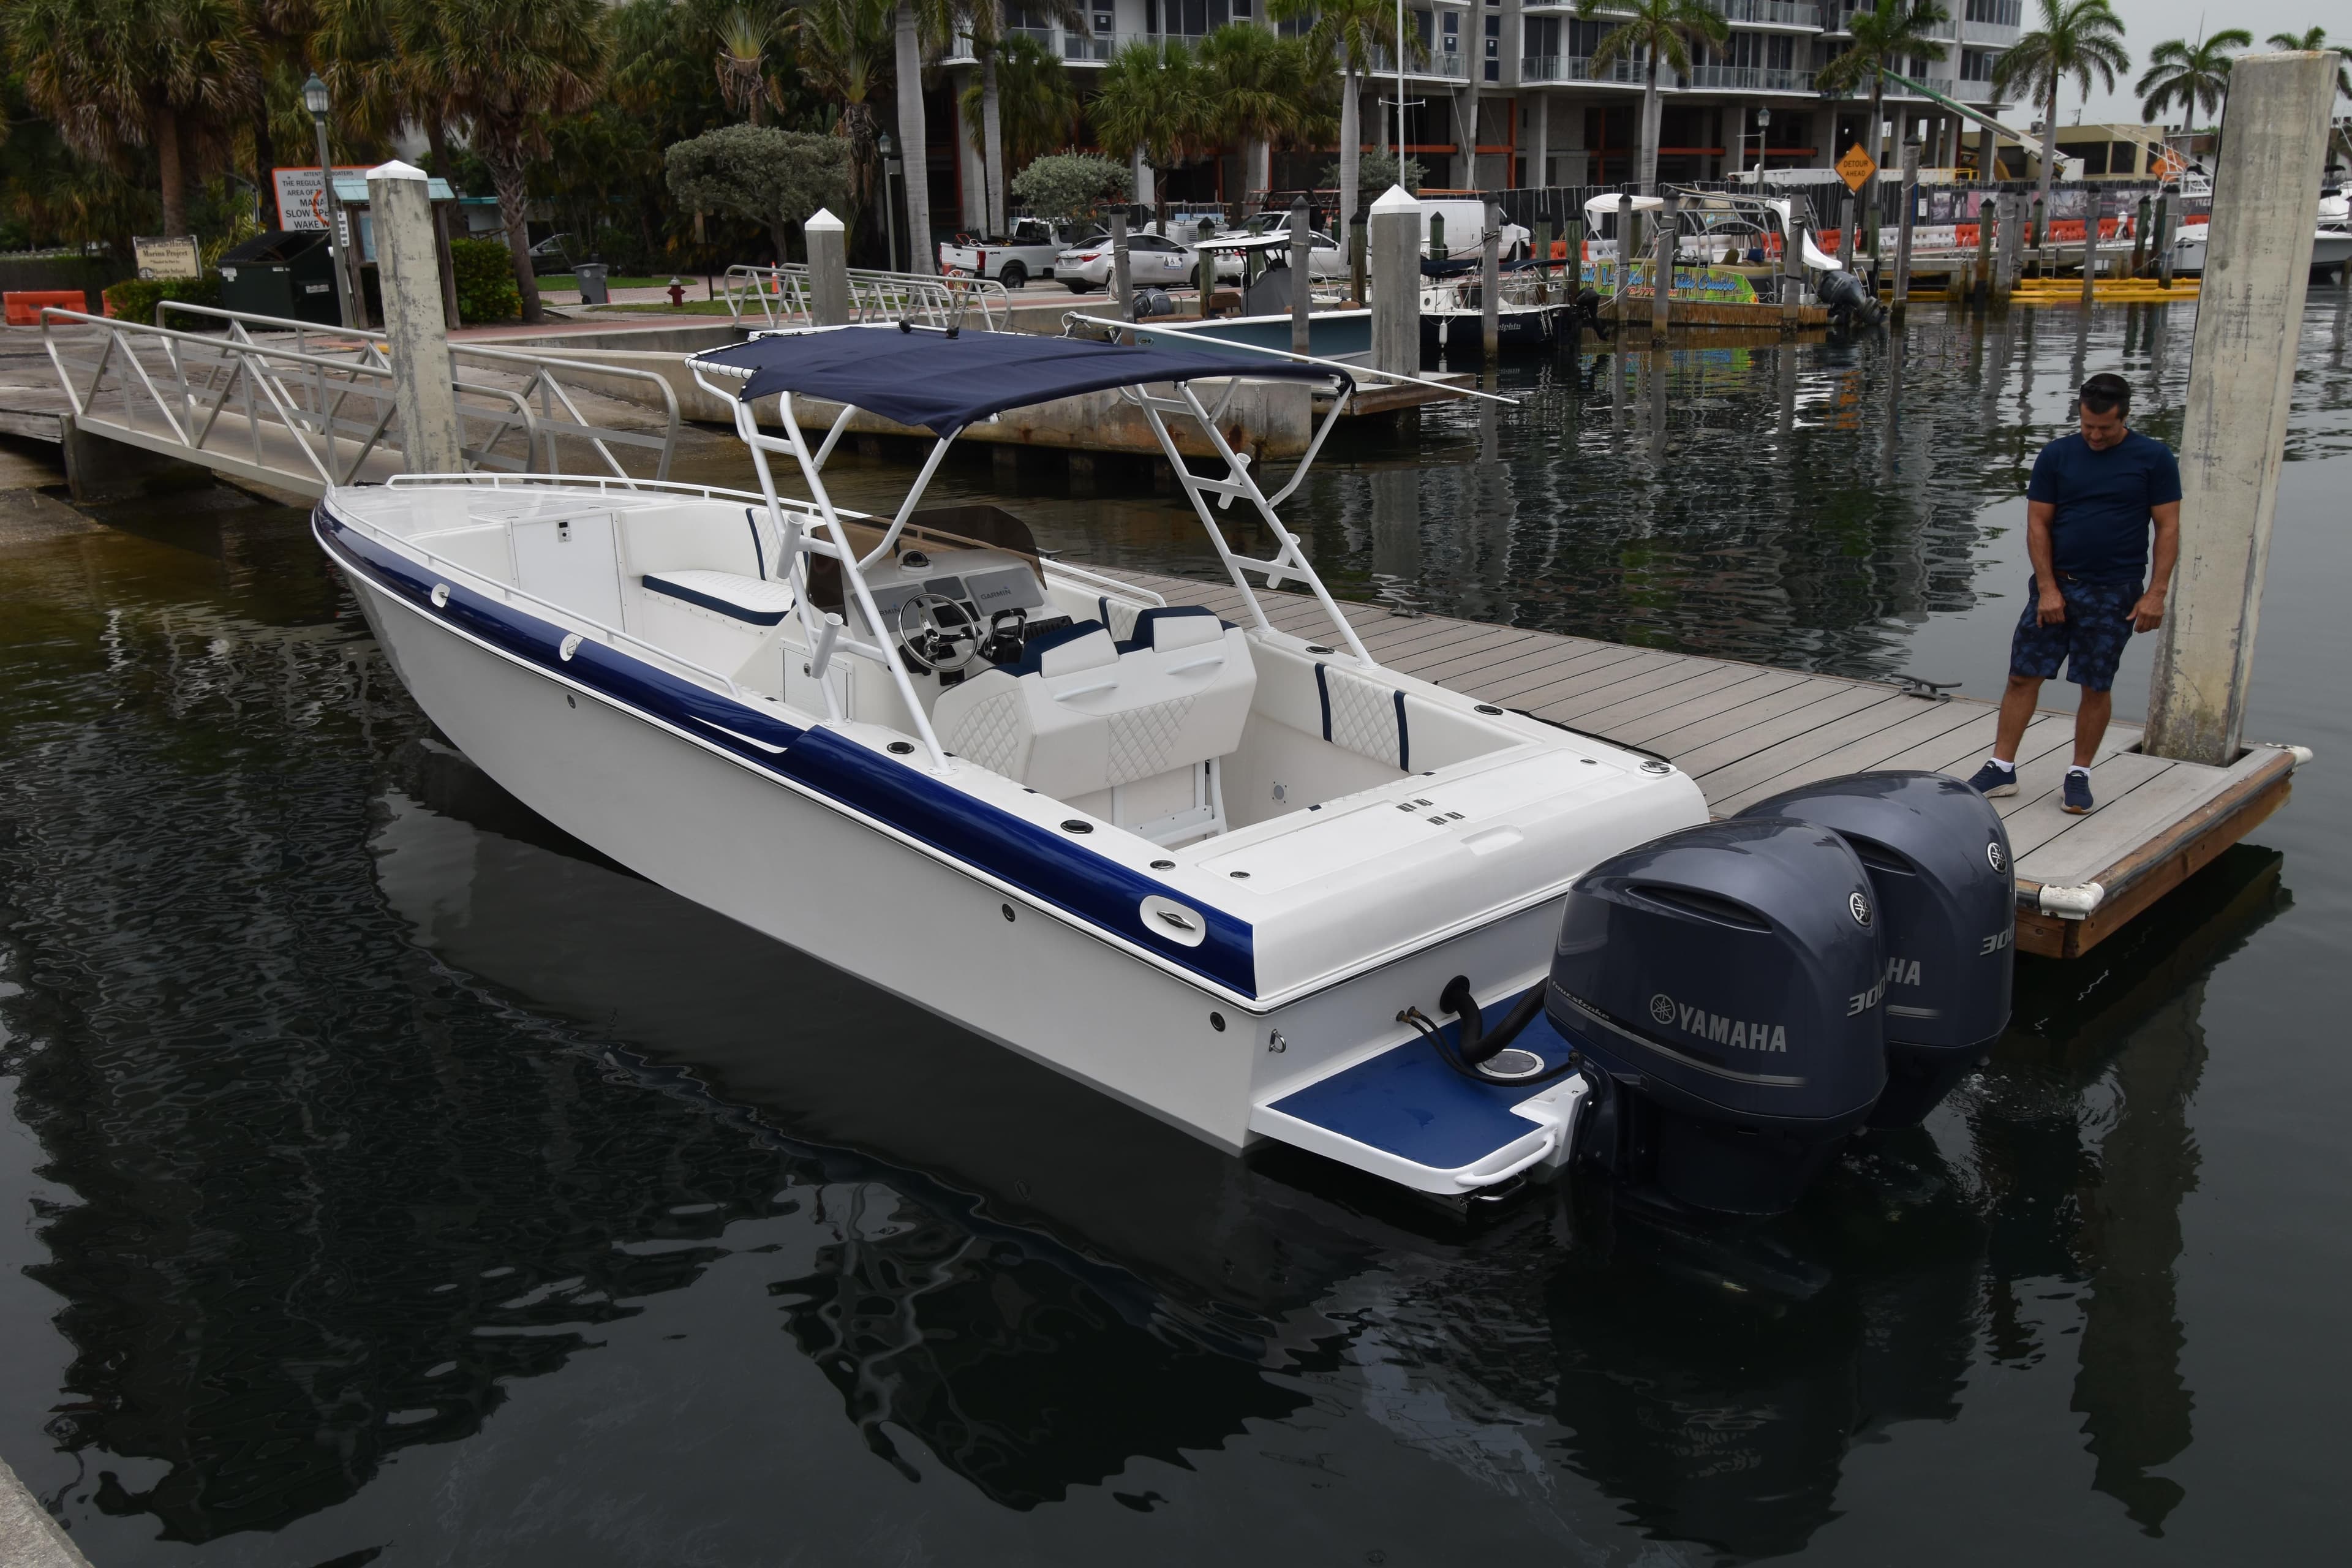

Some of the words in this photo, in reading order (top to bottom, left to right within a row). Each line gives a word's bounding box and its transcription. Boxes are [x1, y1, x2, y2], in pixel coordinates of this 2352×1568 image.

[300, 198, 324, 207] MANA
[285, 209, 311, 218] SLOW
[313, 208, 329, 217] SPE
[293, 220, 320, 228] WAKE
[166, 249, 188, 258] Project
[1674, 273, 1696, 289] Tiki
[1698, 274, 1737, 291] Cruise
[981, 589, 1012, 600] GARMIN
[879, 607, 901, 616] RMIN
[1980, 921, 2015, 956] 300
[1847, 975, 1886, 1017] 300
[1679, 1003, 1787, 1052] YAMAHA
